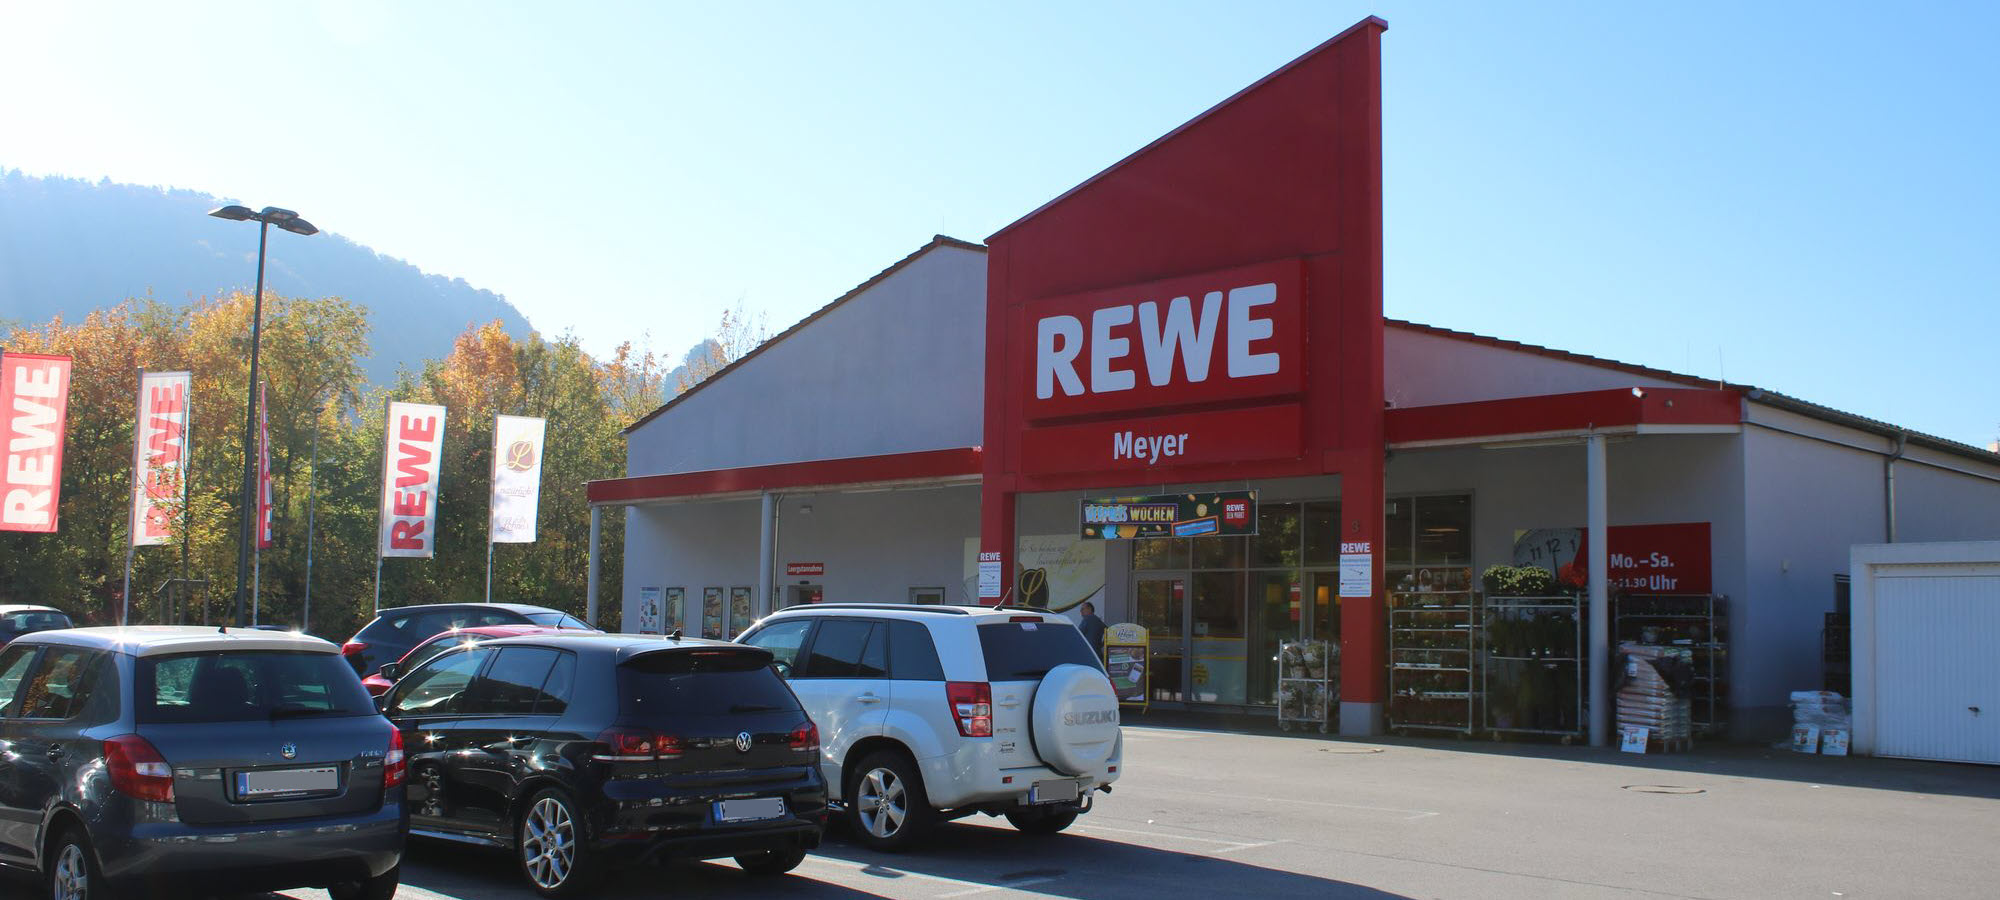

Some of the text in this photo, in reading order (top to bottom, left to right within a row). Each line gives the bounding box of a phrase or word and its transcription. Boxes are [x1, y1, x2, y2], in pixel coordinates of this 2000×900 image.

[1036, 282, 1280, 399] REWE
[3, 366, 60, 524] REWE
[1113, 431, 1188, 465] Meyer
[391, 415, 436, 549] REWE
[1131, 506, 1175, 521] WOCHEN
[1226, 504, 1245, 512] REWE
[1341, 543, 1370, 553] REWE
[1530, 546, 1541, 560] 11
[1546, 538, 1561, 554] 12
[1570, 539, 1576, 552] 1
[980, 552, 1001, 561] REWE
[1650, 575, 1678, 590] Uhr
[1064, 710, 1117, 726] SUZUKI
